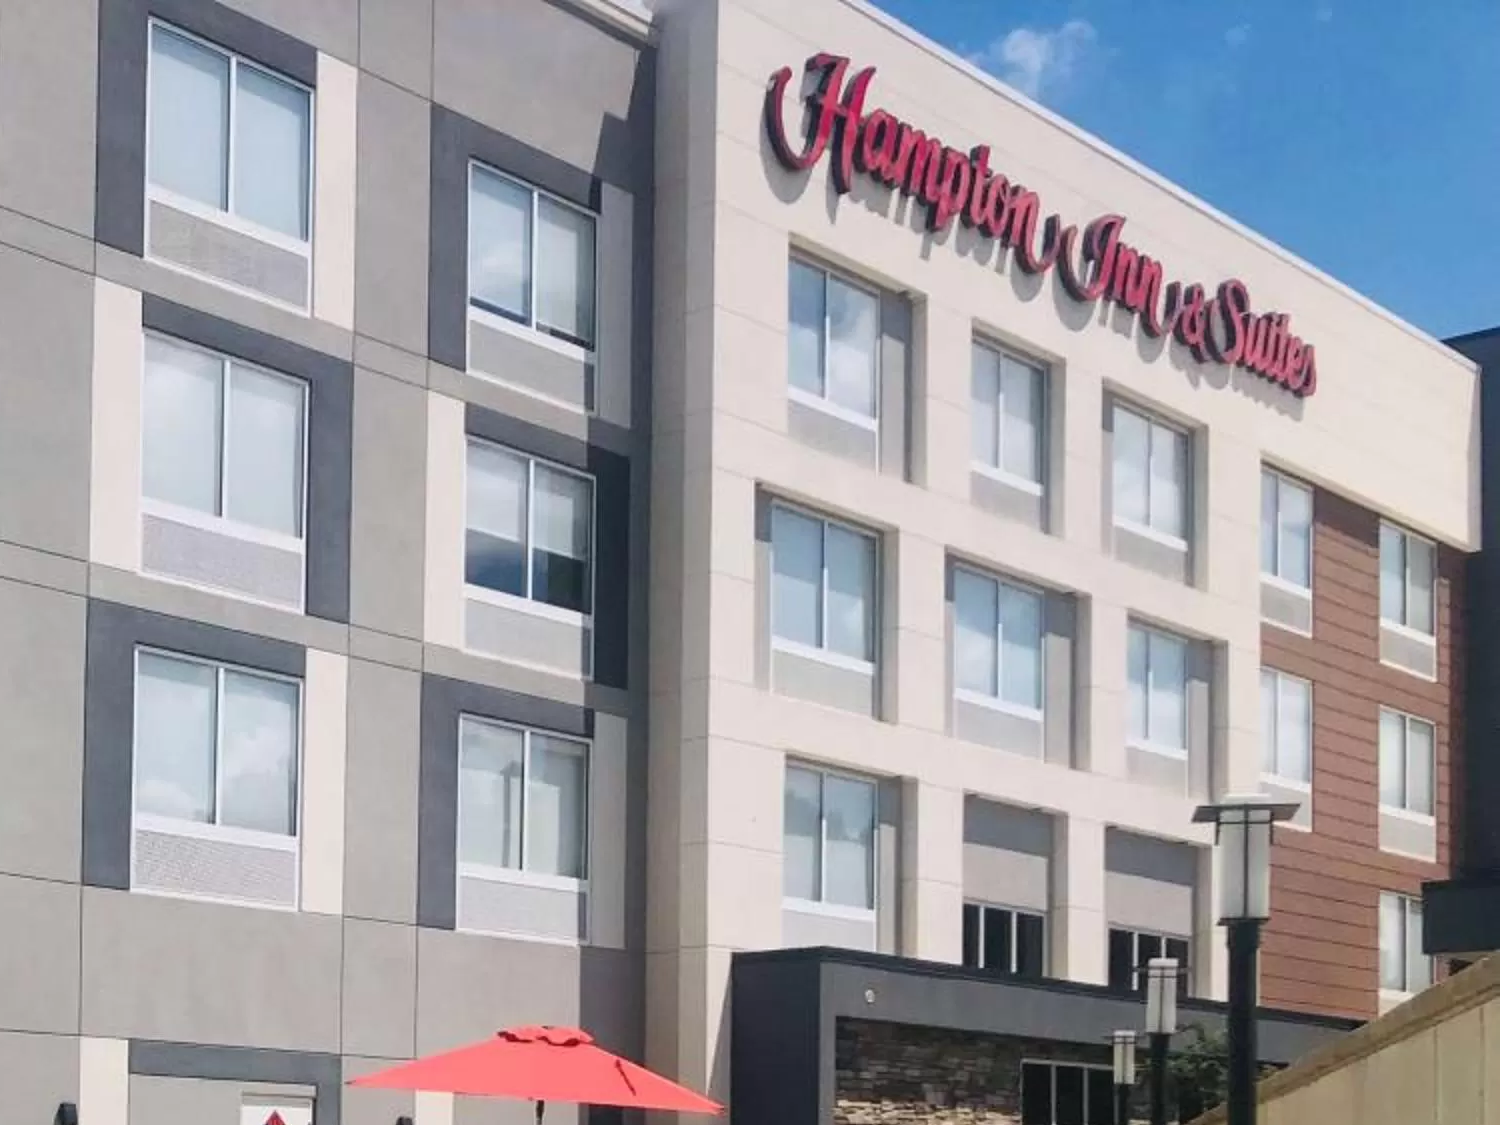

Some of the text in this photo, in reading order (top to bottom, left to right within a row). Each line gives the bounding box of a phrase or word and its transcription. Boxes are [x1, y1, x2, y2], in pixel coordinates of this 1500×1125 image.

[764, 52, 1318, 397] Hampton Inn & Suites
